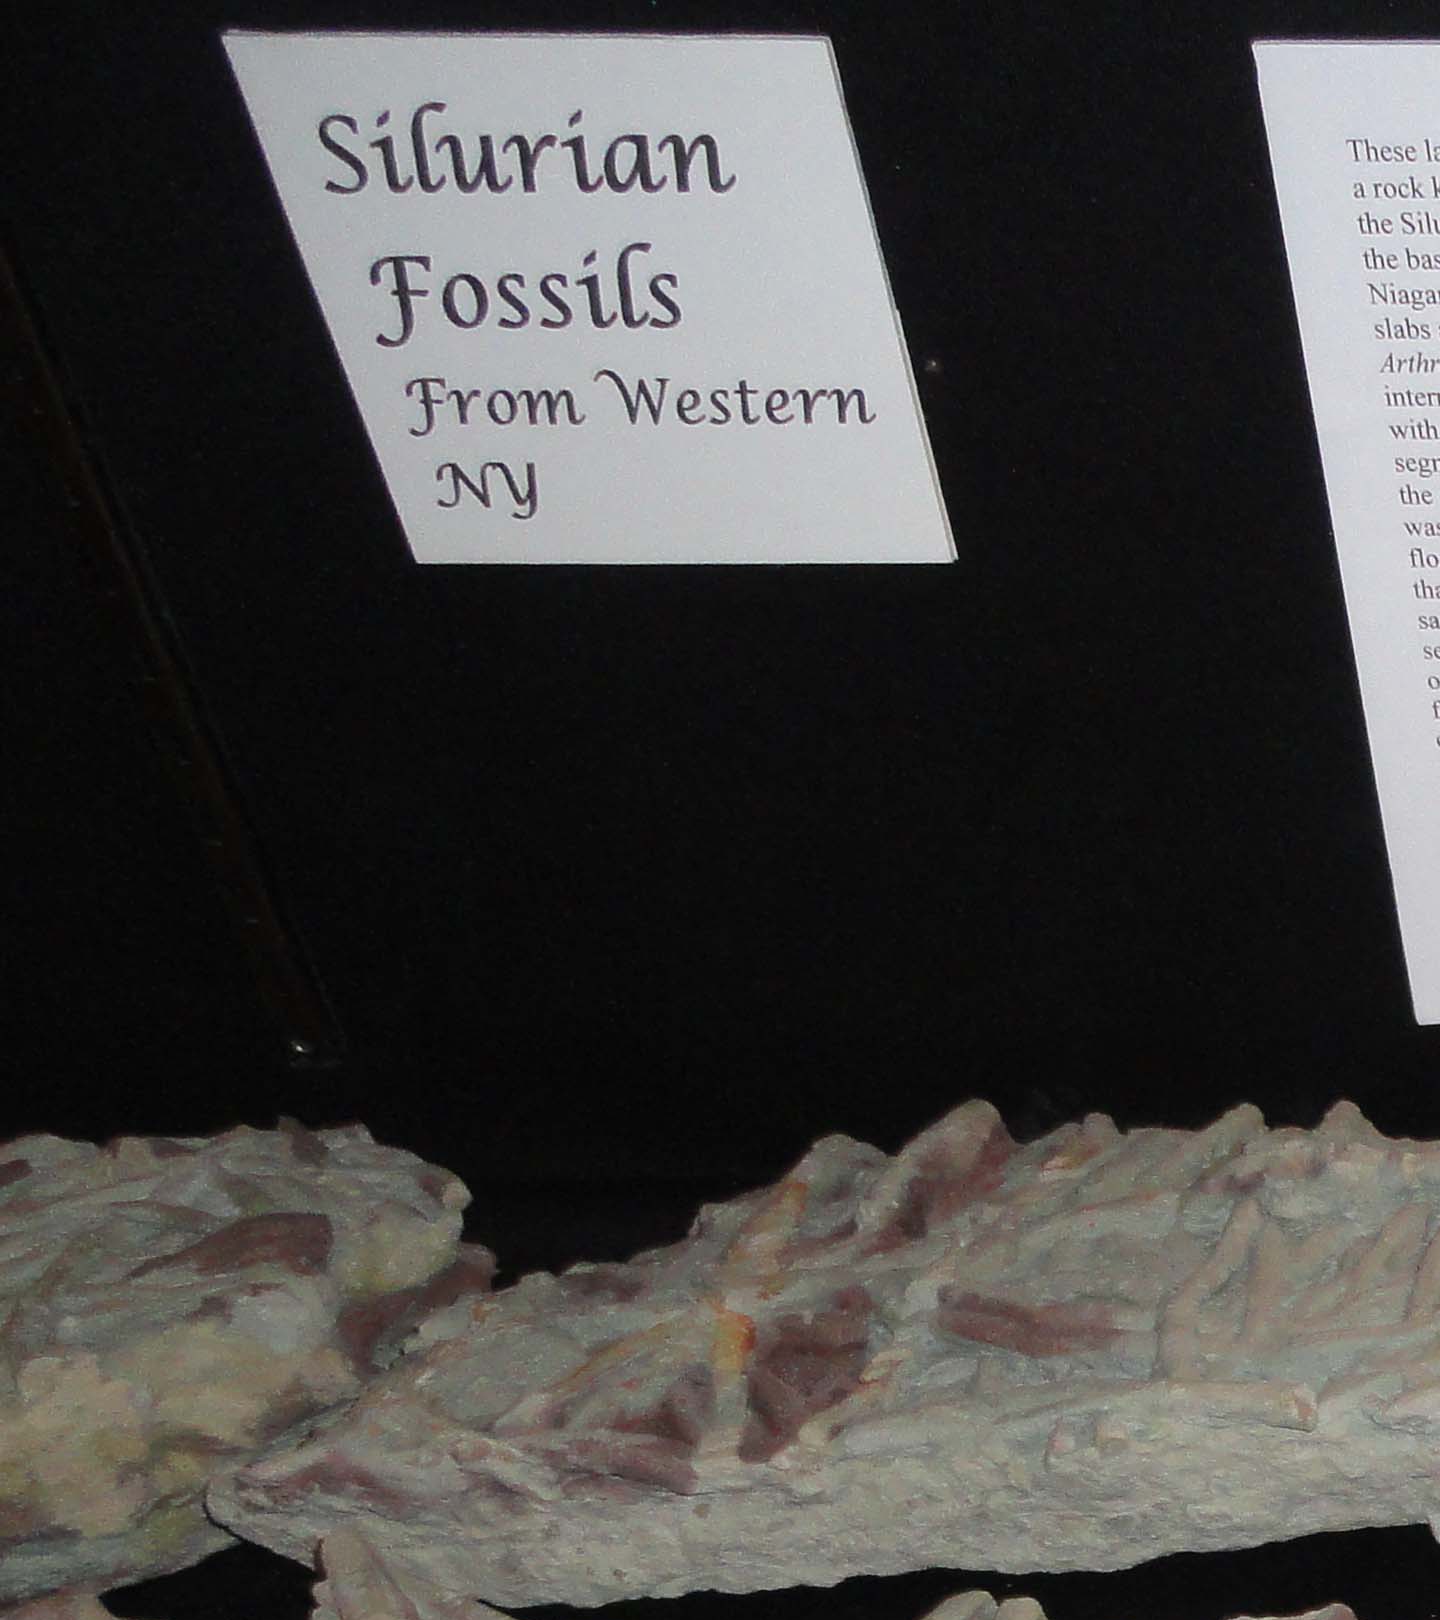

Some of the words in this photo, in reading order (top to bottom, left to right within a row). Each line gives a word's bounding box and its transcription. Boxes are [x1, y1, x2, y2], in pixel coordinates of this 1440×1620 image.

[318, 102, 736, 194] Silurian
[1346, 139, 1416, 162] These
[1357, 212, 1393, 234] the
[1363, 248, 1398, 269] the
[369, 243, 681, 347] Fossils
[1375, 317, 1431, 339] slabs
[405, 378, 585, 437] From
[594, 369, 876, 425] Western
[1389, 418, 1439, 439] with
[436, 462, 537, 519] NY
[1400, 484, 1432, 504] the
